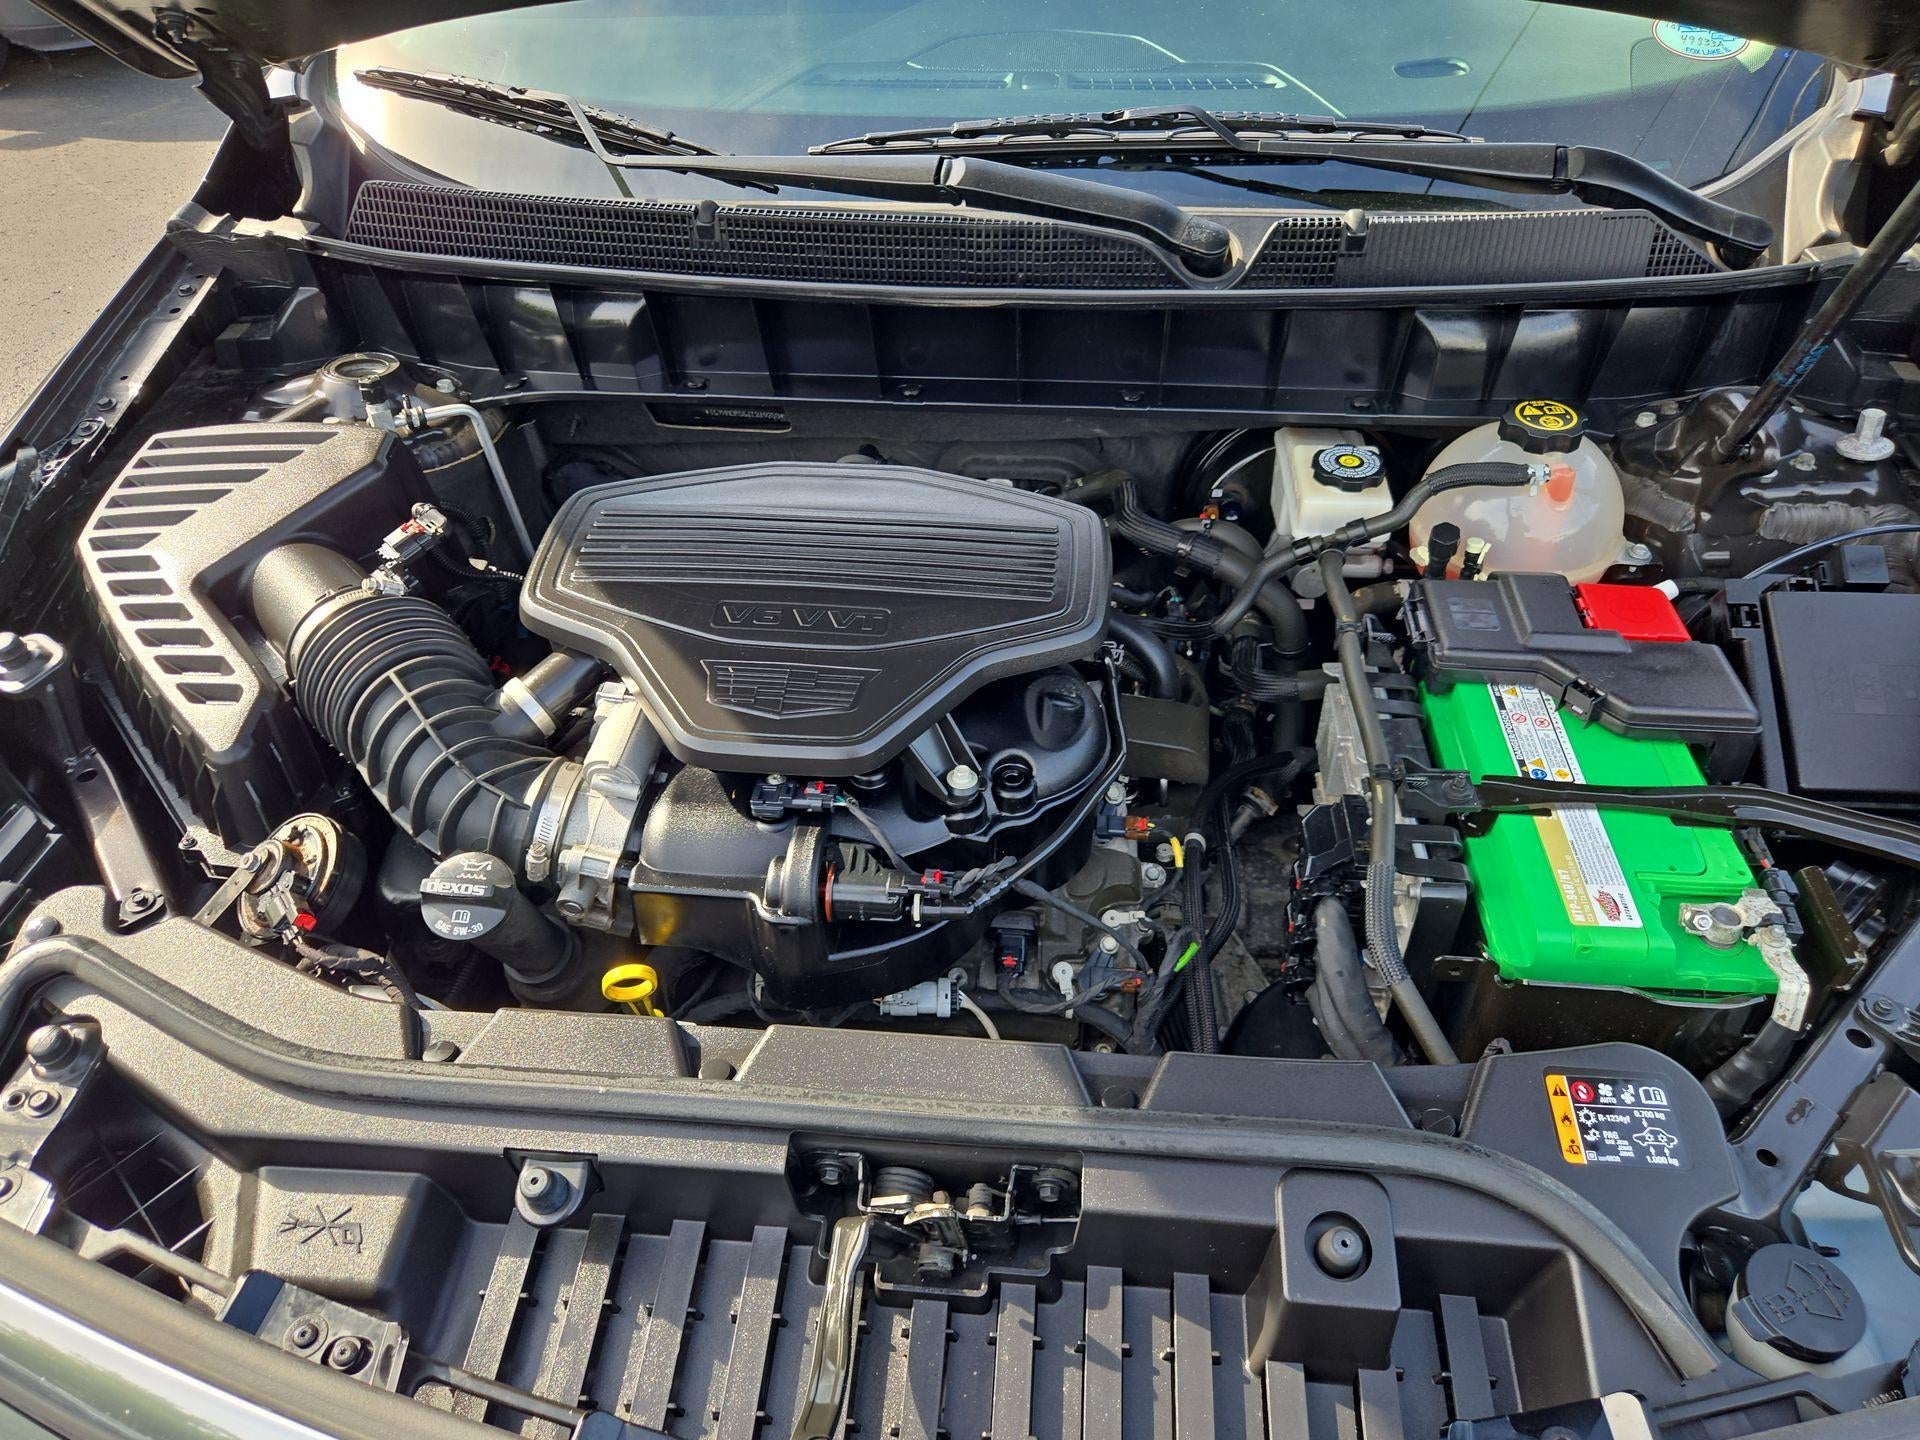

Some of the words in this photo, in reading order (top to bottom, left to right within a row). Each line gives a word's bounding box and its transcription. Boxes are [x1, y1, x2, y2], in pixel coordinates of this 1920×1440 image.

[1685, 46, 1700, 55] FOX
[722, 605, 782, 625] V6
[792, 608, 885, 632] VVT
[1499, 709, 1524, 760] DANGER/POISON
[426, 879, 486, 896] dexos
[434, 919, 452, 934] SAE
[452, 922, 484, 936] 5W-30
[1600, 1096, 1617, 1104] AUTO
[1655, 1111, 1666, 1120] kg
[1602, 1130, 1619, 1139] PAG
[1668, 1157, 1680, 1167] kg
